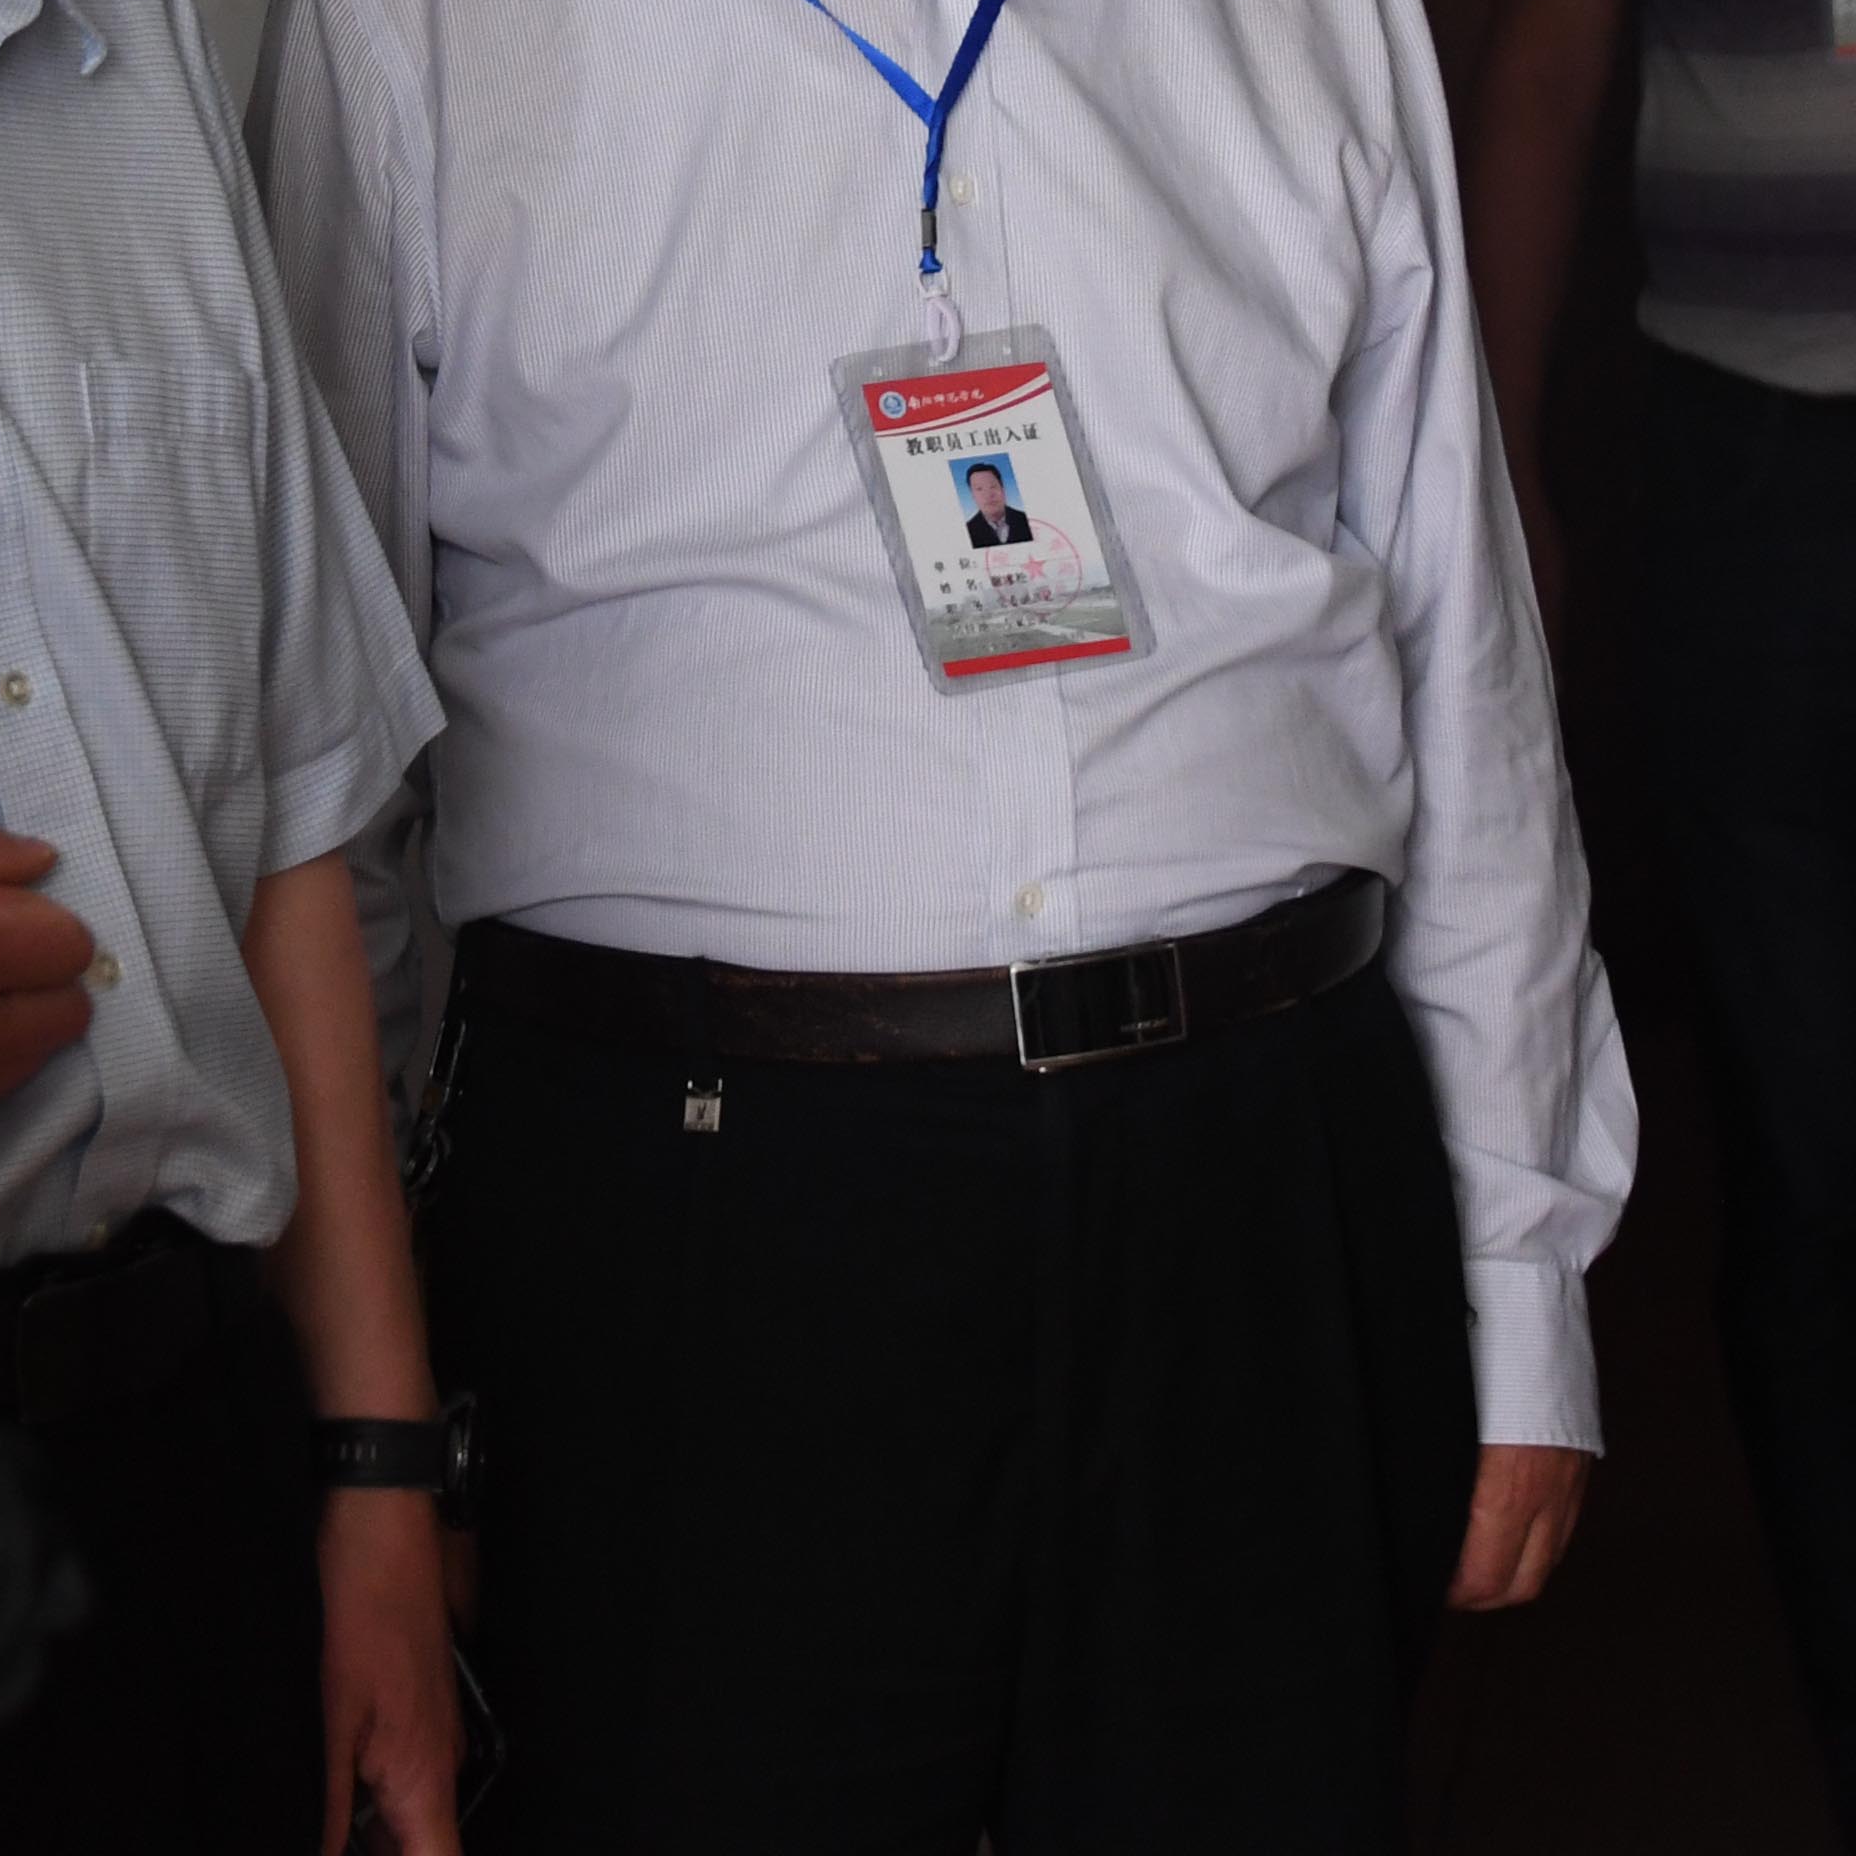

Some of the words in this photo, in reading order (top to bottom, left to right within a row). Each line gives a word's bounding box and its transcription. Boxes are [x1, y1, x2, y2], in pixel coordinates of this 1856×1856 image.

[905, 422, 1041, 456] 教职员工出入证
